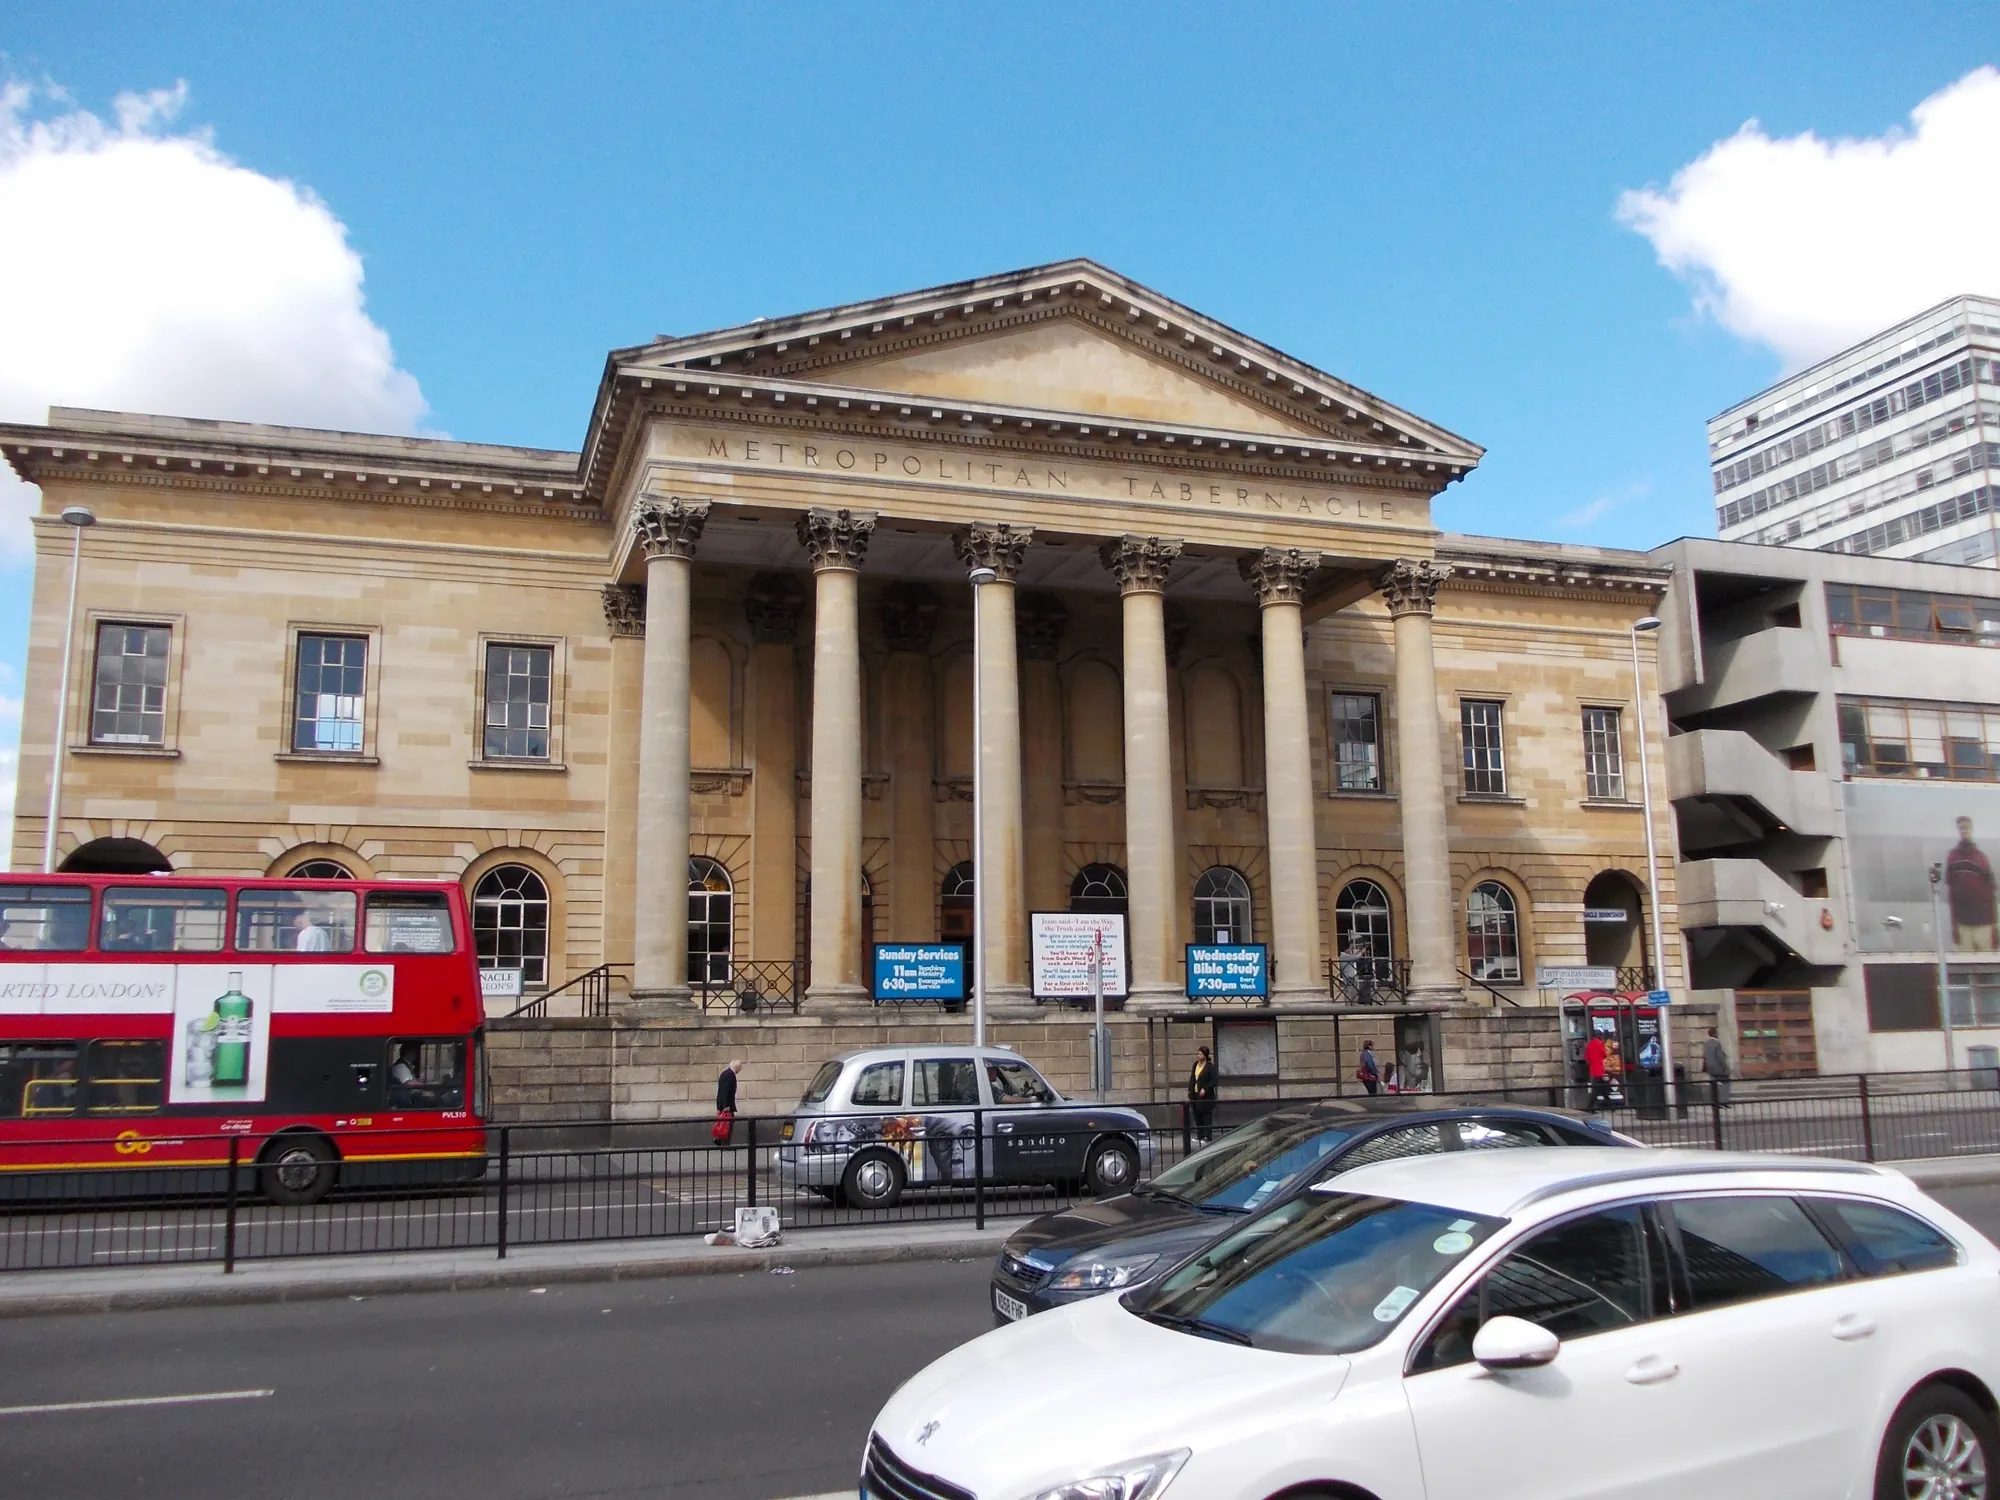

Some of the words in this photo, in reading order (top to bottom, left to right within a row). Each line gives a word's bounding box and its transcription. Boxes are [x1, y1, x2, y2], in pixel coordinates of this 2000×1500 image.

[707, 437, 1068, 488] METROPOLITAN
[1122, 476, 1393, 520] TABERNACLE
[879, 948, 917, 963] Sunday
[917, 948, 959, 960] Services
[1192, 949, 1260, 963] Wednesday
[893, 965, 917, 977] 11am
[1193, 963, 1224, 974] Bible
[1226, 962, 1260, 977] Study
[65, 983, 167, 998] LONDON?
[1007, 1135, 1066, 1147] sandro
